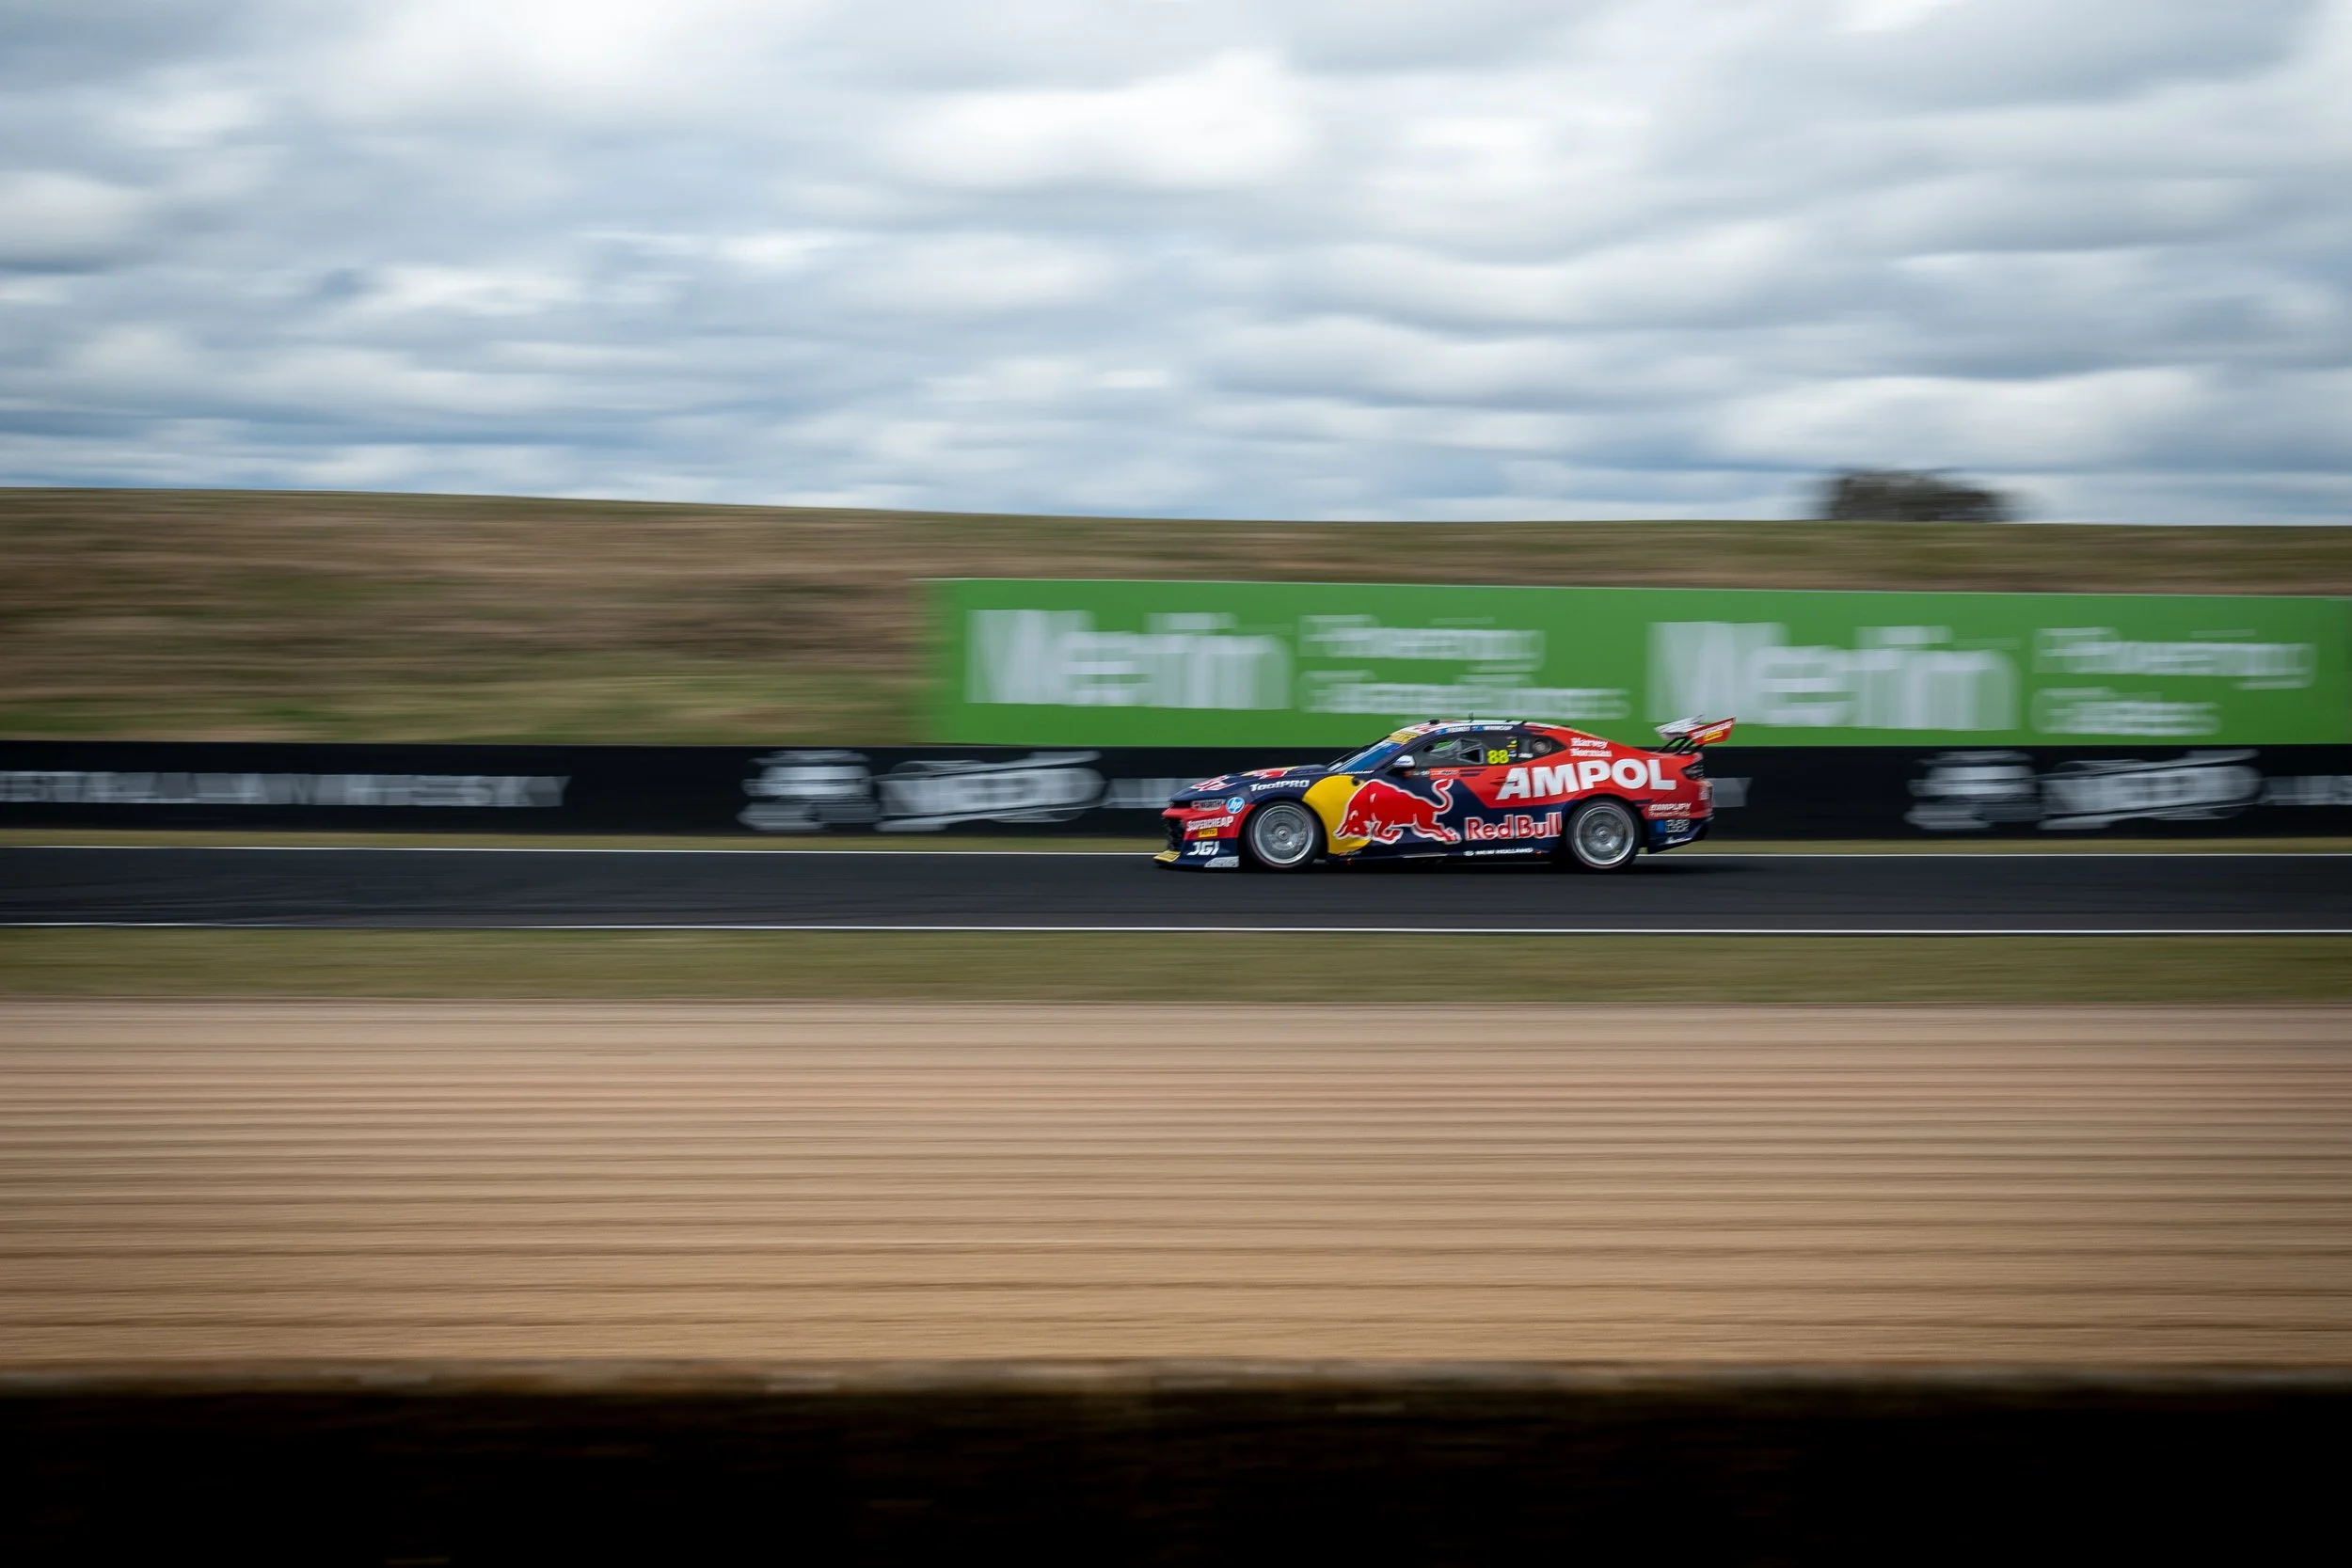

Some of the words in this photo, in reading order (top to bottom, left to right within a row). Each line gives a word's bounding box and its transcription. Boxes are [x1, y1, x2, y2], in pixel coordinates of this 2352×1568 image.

[1570, 737, 1608, 750] Harvey
[1487, 749, 1509, 764] 88
[1570, 748, 1612, 757] Norman
[1249, 780, 1311, 791] ToolPRO
[1497, 758, 1677, 800] AMPOL
[1228, 798, 1244, 814] hp
[1186, 816, 1234, 832] SUPERCHEAP
[1464, 814, 1514, 841] Red
[1515, 811, 1562, 839] Bull
[1186, 840, 1220, 856] JGI
